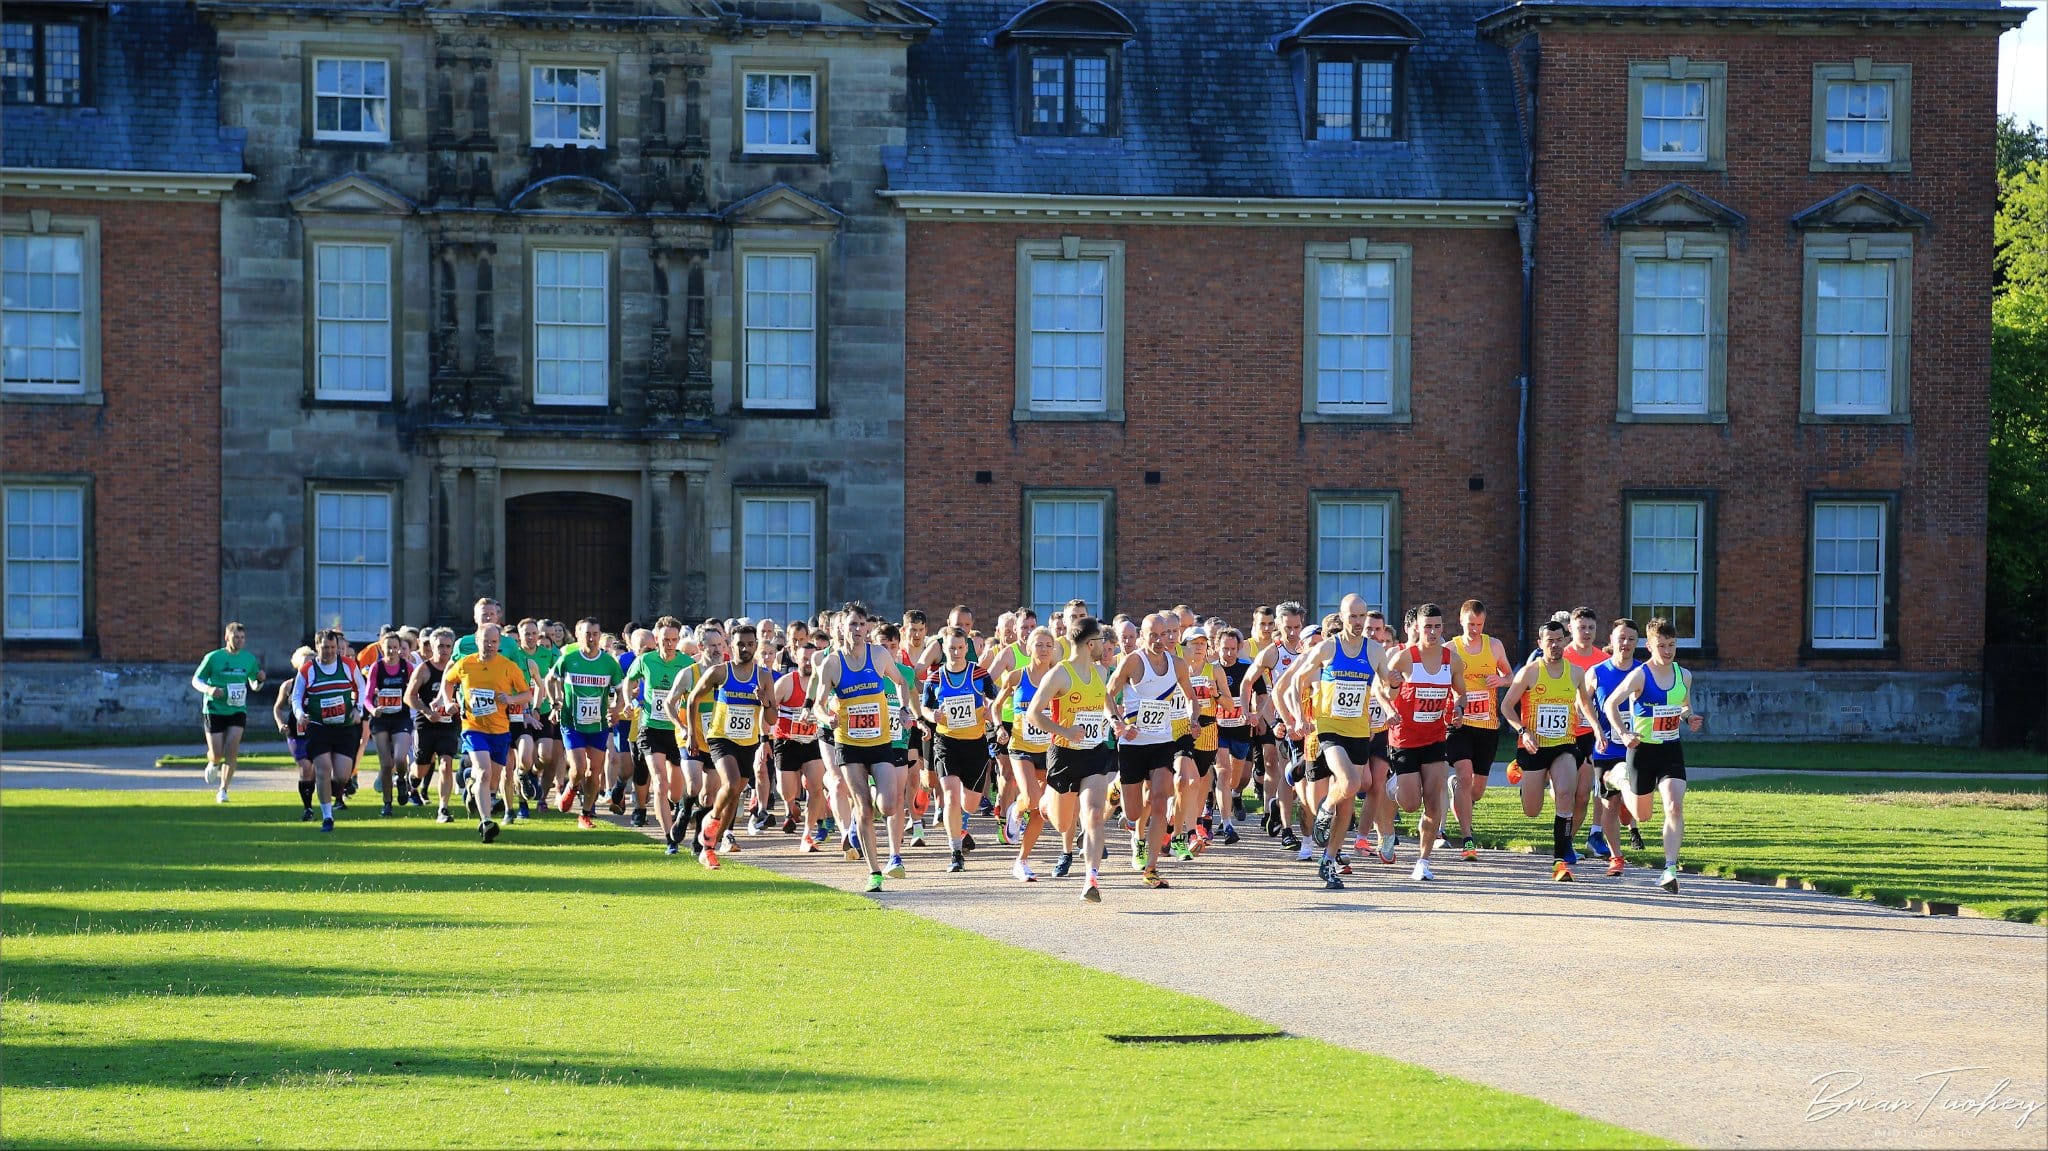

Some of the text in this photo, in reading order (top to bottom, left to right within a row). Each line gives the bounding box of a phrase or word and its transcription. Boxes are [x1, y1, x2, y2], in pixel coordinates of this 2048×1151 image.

[1331, 670, 1370, 680] WILMSLOW
[841, 682, 879, 695] WILMSLOW
[1337, 692, 1361, 707] 834
[1419, 699, 1441, 712] 202
[581, 705, 598, 717] 914
[950, 704, 971, 719] 924
[1066, 704, 1105, 714] ALTRINCHA
[1468, 701, 1485, 714] 161
[729, 716, 751, 730] 858
[855, 714, 876, 728] 138
[1142, 710, 1165, 725] 822
[1540, 714, 1567, 729] 1153
